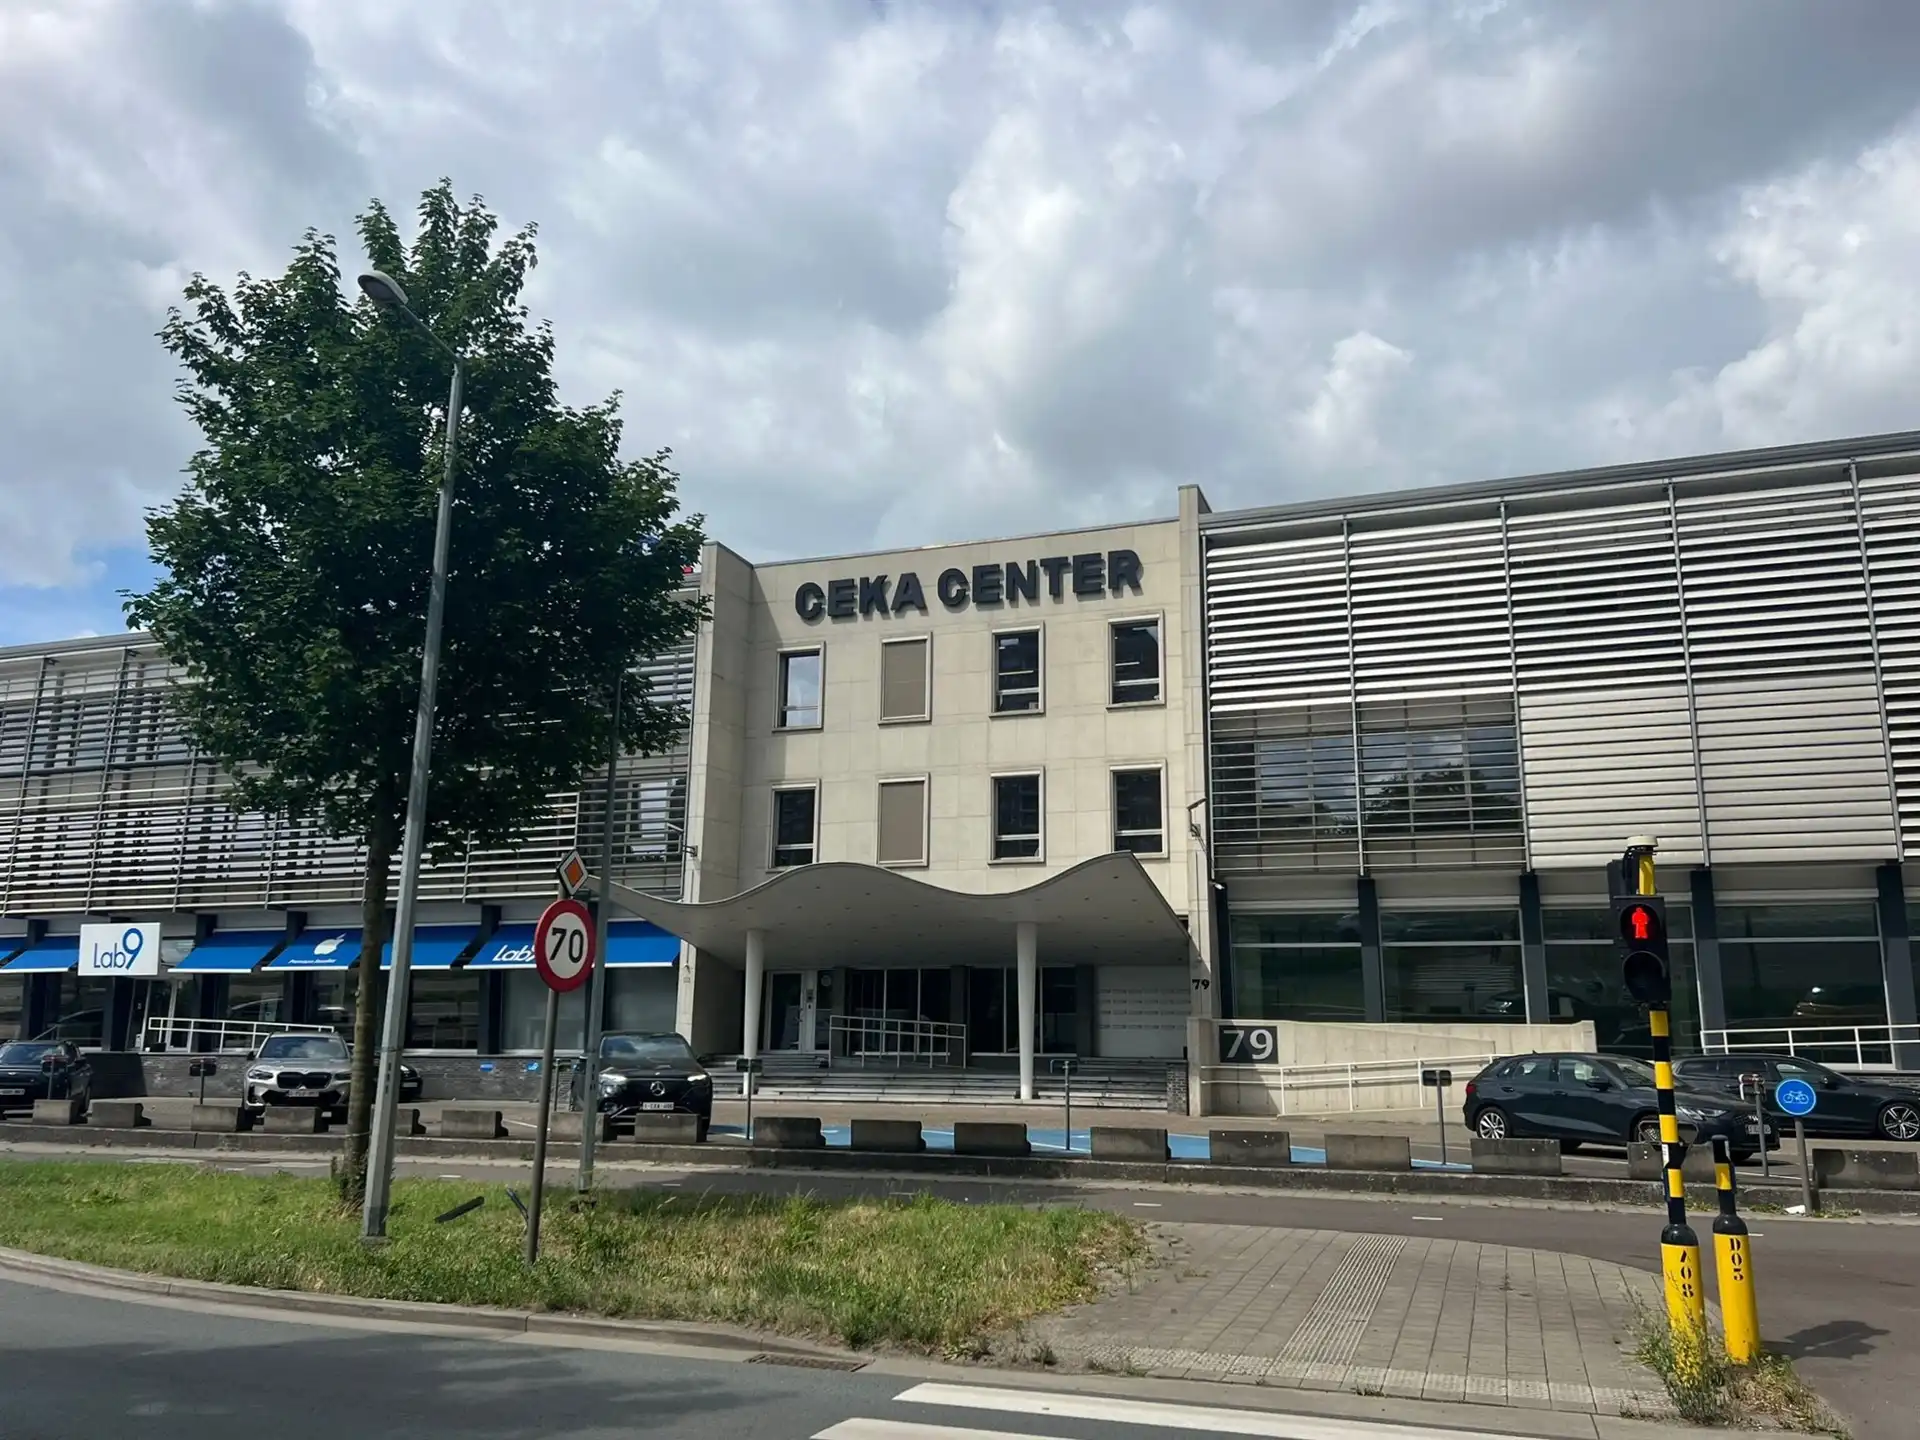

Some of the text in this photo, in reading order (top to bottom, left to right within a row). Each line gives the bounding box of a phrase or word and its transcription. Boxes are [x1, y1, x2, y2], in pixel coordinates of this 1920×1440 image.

[795, 549, 1143, 620] CEKA CENTER
[93, 928, 143, 970] Lab9
[549, 927, 584, 963] 70
[1191, 978, 1210, 990] 79
[1223, 1029, 1273, 1060] 79
[1729, 1238, 1744, 1281] D05
